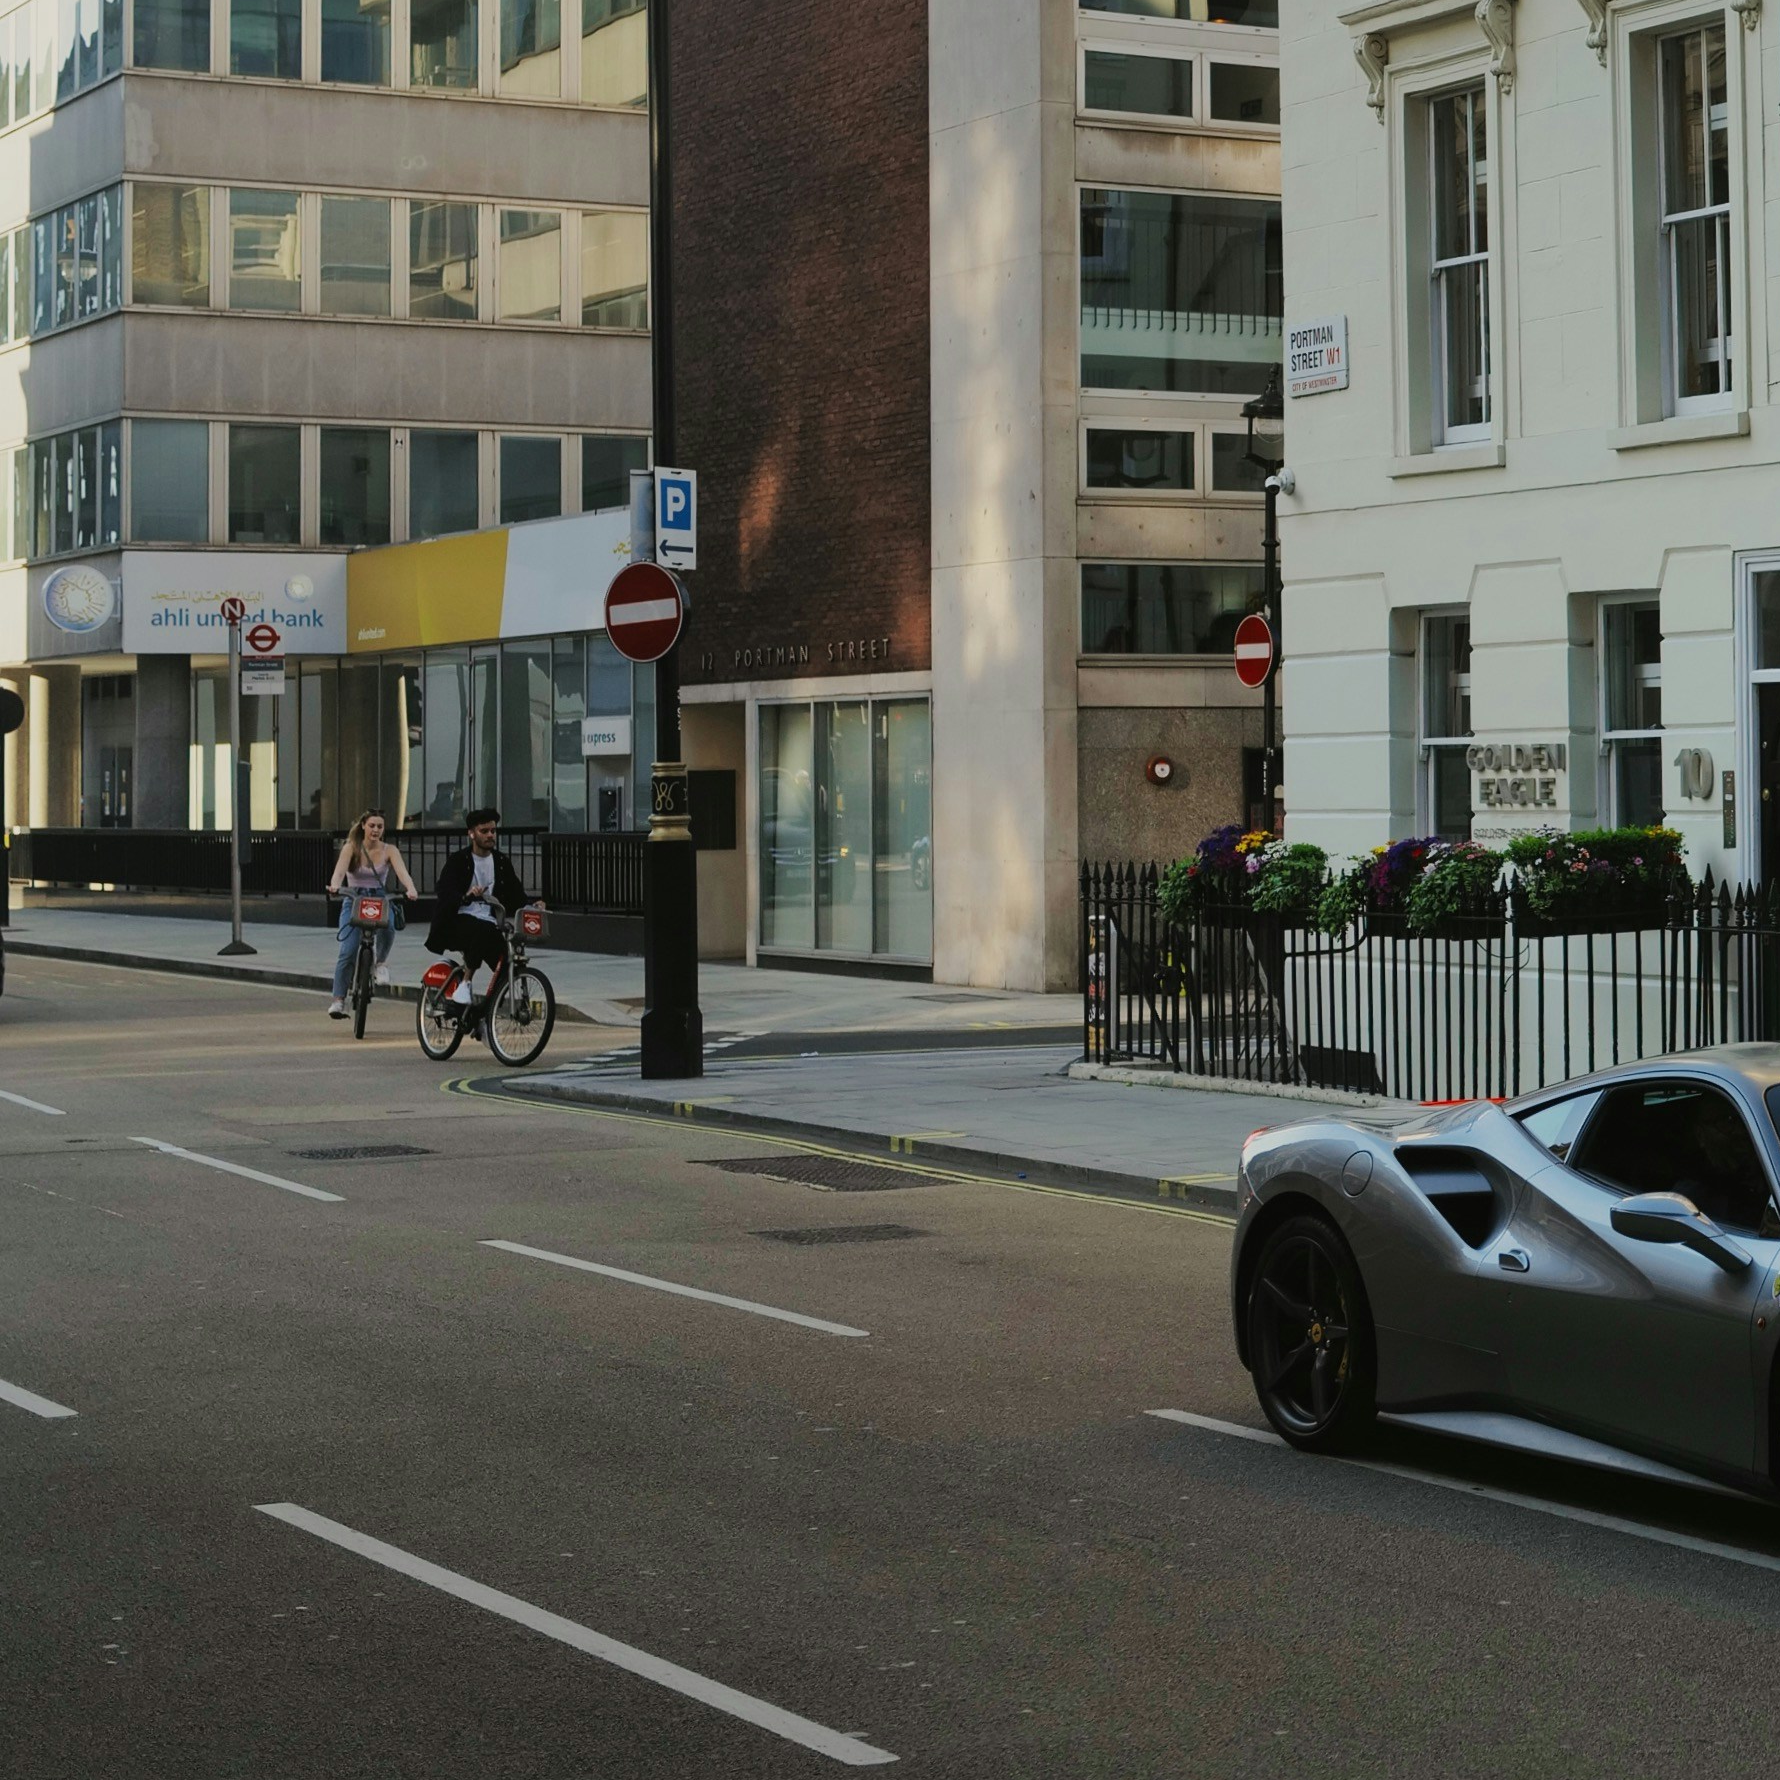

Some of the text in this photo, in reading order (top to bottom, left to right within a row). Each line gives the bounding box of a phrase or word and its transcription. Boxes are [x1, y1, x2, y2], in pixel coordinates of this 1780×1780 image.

[1290, 324, 1333, 350] PORTMAN
[1291, 346, 1340, 372] STREET W1
[1292, 376, 1337, 392] CITY OF WESTMINSTER
[666, 486, 686, 522] P
[151, 608, 324, 627] ahli uned bank
[223, 600, 242, 619] N
[701, 638, 890, 670] 12 PORTMAN STREET
[587, 732, 616, 746] express
[1466, 743, 1566, 772] GOLDEN
[1674, 748, 1715, 801] 10
[1479, 777, 1557, 807] EAGLE
